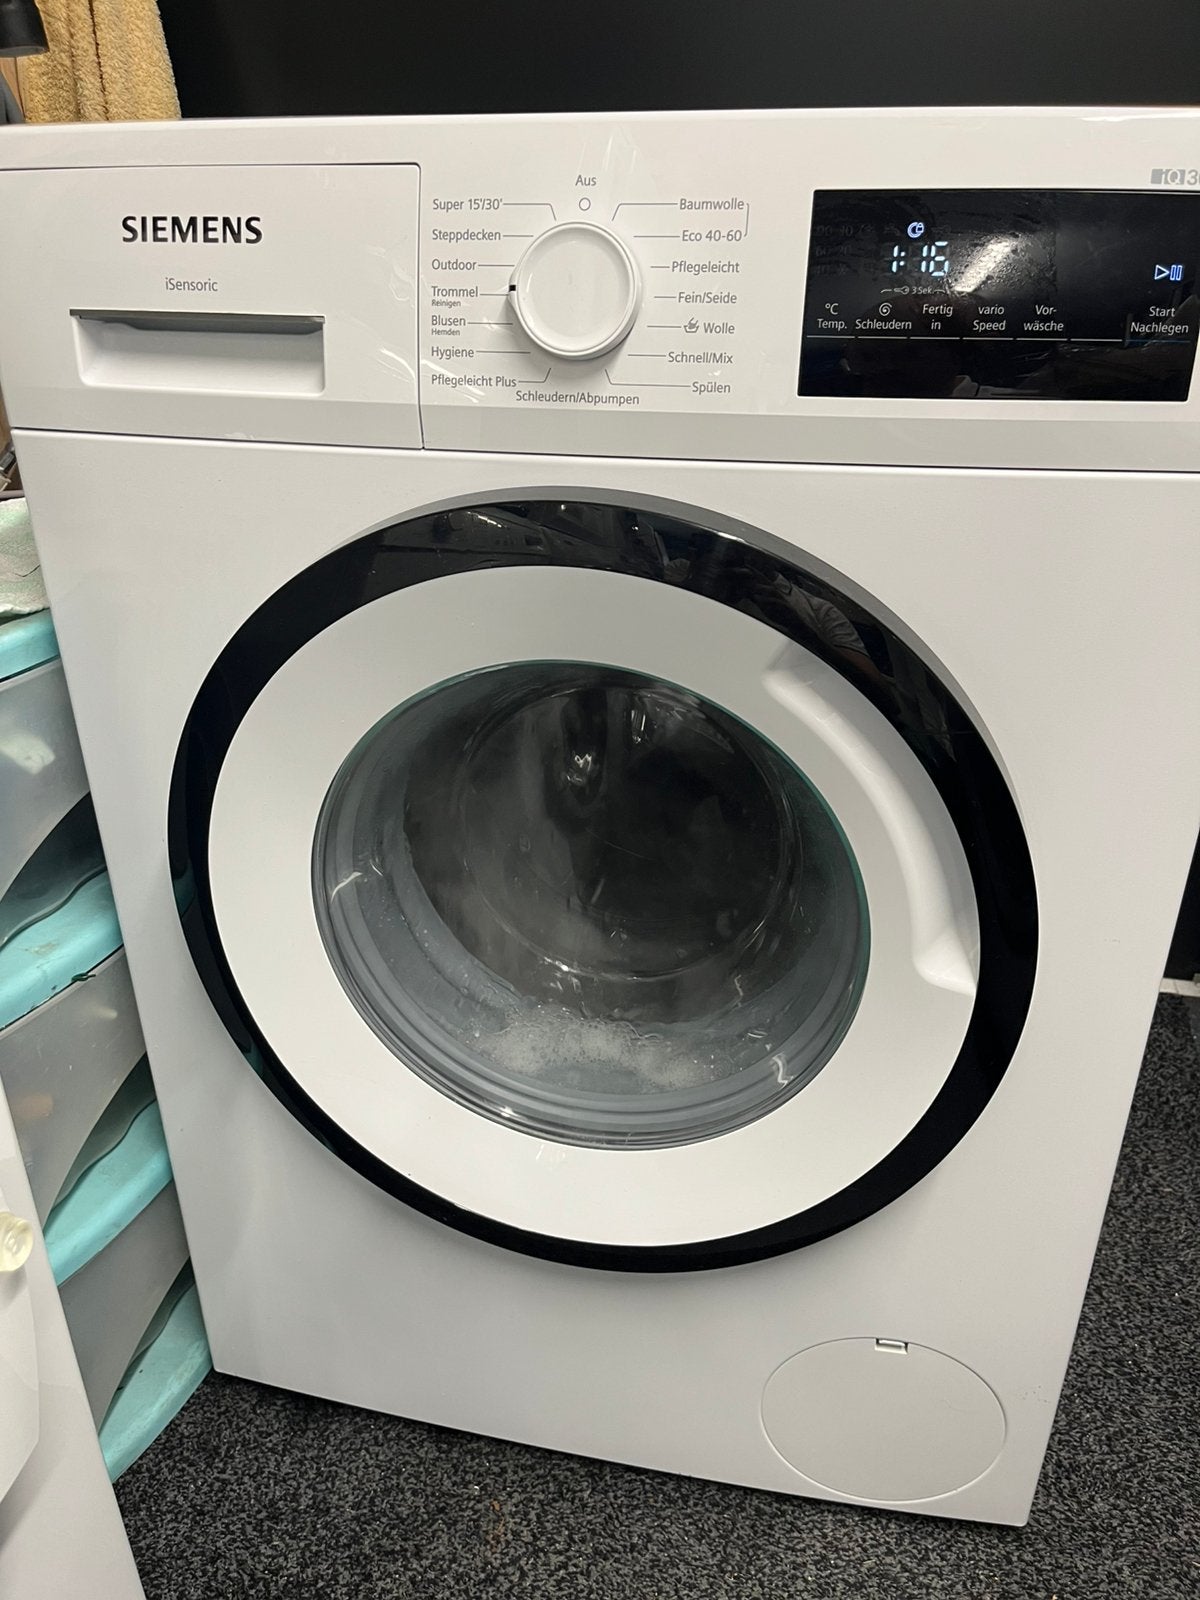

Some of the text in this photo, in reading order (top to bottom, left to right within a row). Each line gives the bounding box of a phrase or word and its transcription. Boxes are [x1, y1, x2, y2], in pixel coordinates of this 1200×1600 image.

[575, 174, 597, 187] Aus
[432, 197, 504, 212] Super 15'/30'
[679, 198, 745, 211] Baumwolle
[121, 215, 263, 244] SIEMENS
[432, 228, 502, 243] Steppdecken
[682, 229, 742, 242] Eco 40-60
[431, 257, 477, 271] Outdoor
[891, 241, 949, 276] 1:16
[671, 260, 740, 276] Pflegeleicht
[165, 277, 218, 292] iSensoric
[911, 286, 917, 295] 3
[431, 285, 479, 298] Trommel
[678, 291, 737, 305] Fein/Seide
[431, 299, 461, 308] Reinigen
[825, 303, 839, 315] °C
[922, 303, 954, 317] Fertig
[977, 303, 1004, 316] vario
[1035, 304, 1057, 315] Vor-
[1149, 306, 1175, 317] Start
[431, 314, 466, 326] Blusen
[817, 319, 848, 332] Temp.
[855, 319, 912, 330] Schleudern
[931, 319, 941, 330] in
[972, 320, 1006, 333] Speed
[1023, 320, 1065, 332] wäsche
[431, 328, 460, 337] Hemden
[703, 322, 735, 334] Wolle
[1130, 322, 1189, 334] Nachlegen
[431, 346, 474, 360] Hygiene
[667, 352, 733, 365] Schnell/Mix
[431, 374, 517, 390] Pflegeleicht Plus
[692, 381, 731, 394] Spülen
[515, 391, 640, 406] Schleudern/Abpumpen
